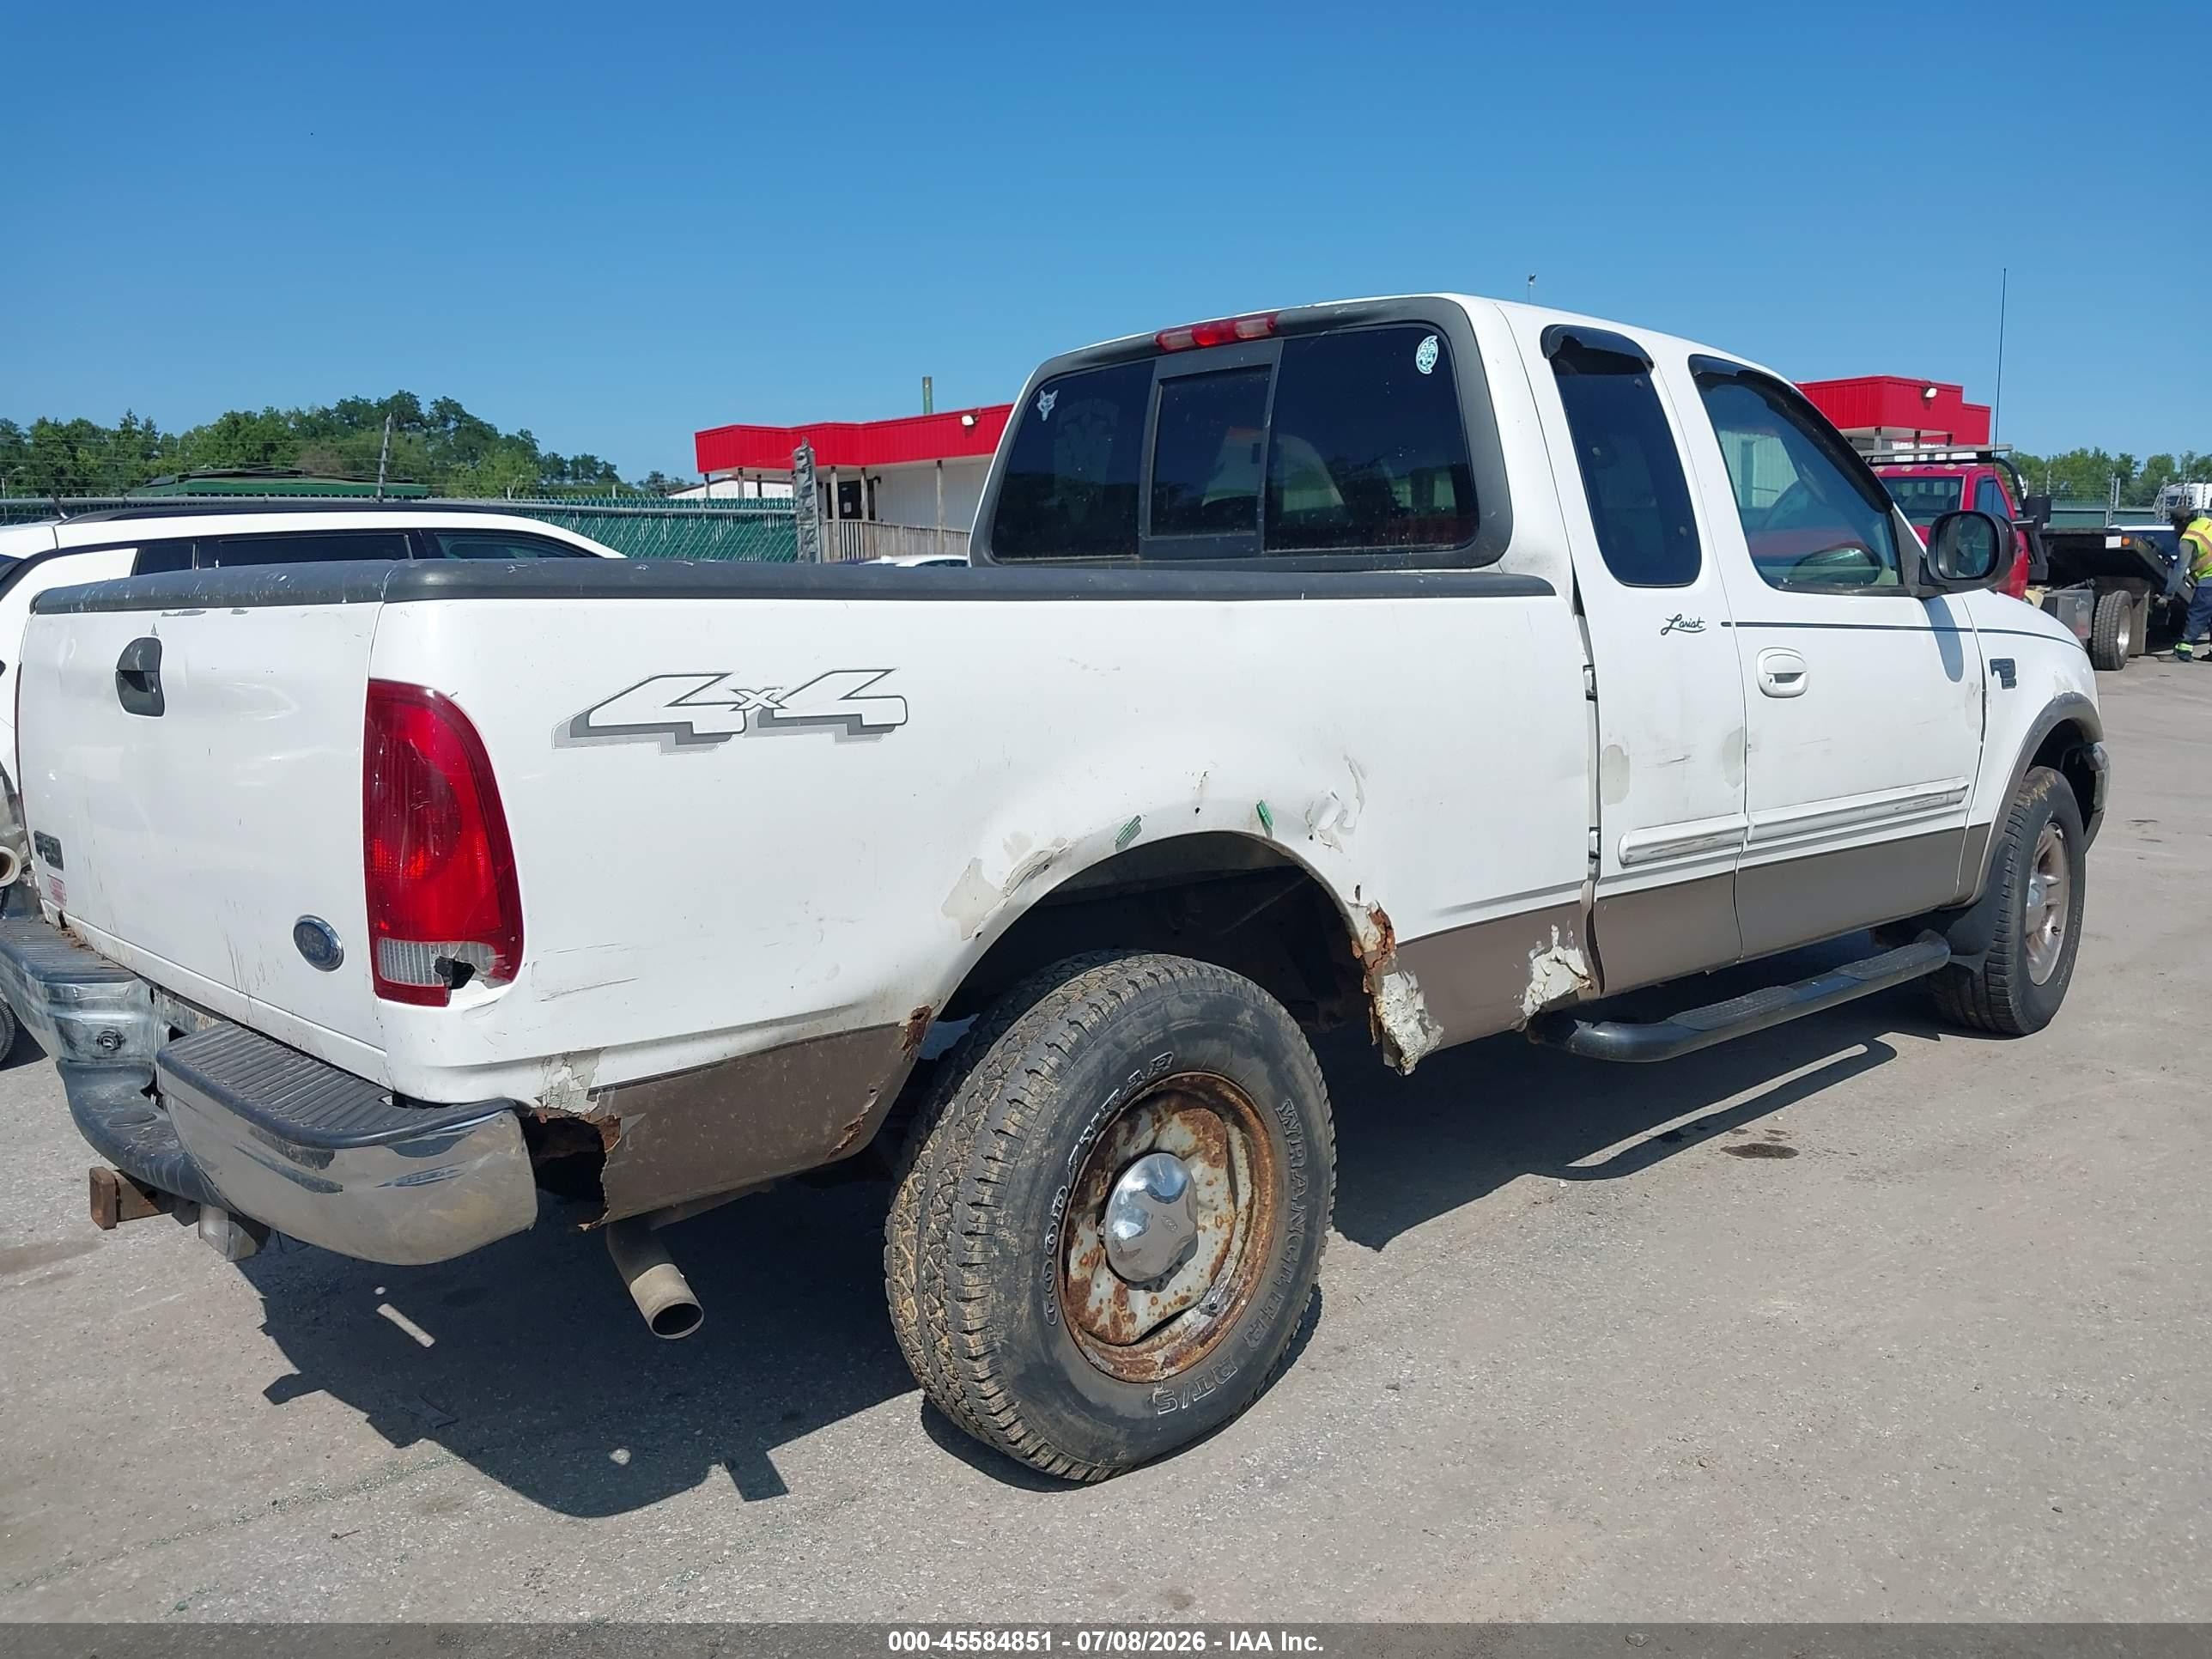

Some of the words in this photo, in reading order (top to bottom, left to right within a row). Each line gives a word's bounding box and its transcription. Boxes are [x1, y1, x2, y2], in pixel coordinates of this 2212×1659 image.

[1660, 613, 1707, 635] Lariat
[1242, 1098, 1310, 1352] WRANGLER
[1154, 1355, 1238, 1415] RT/S
